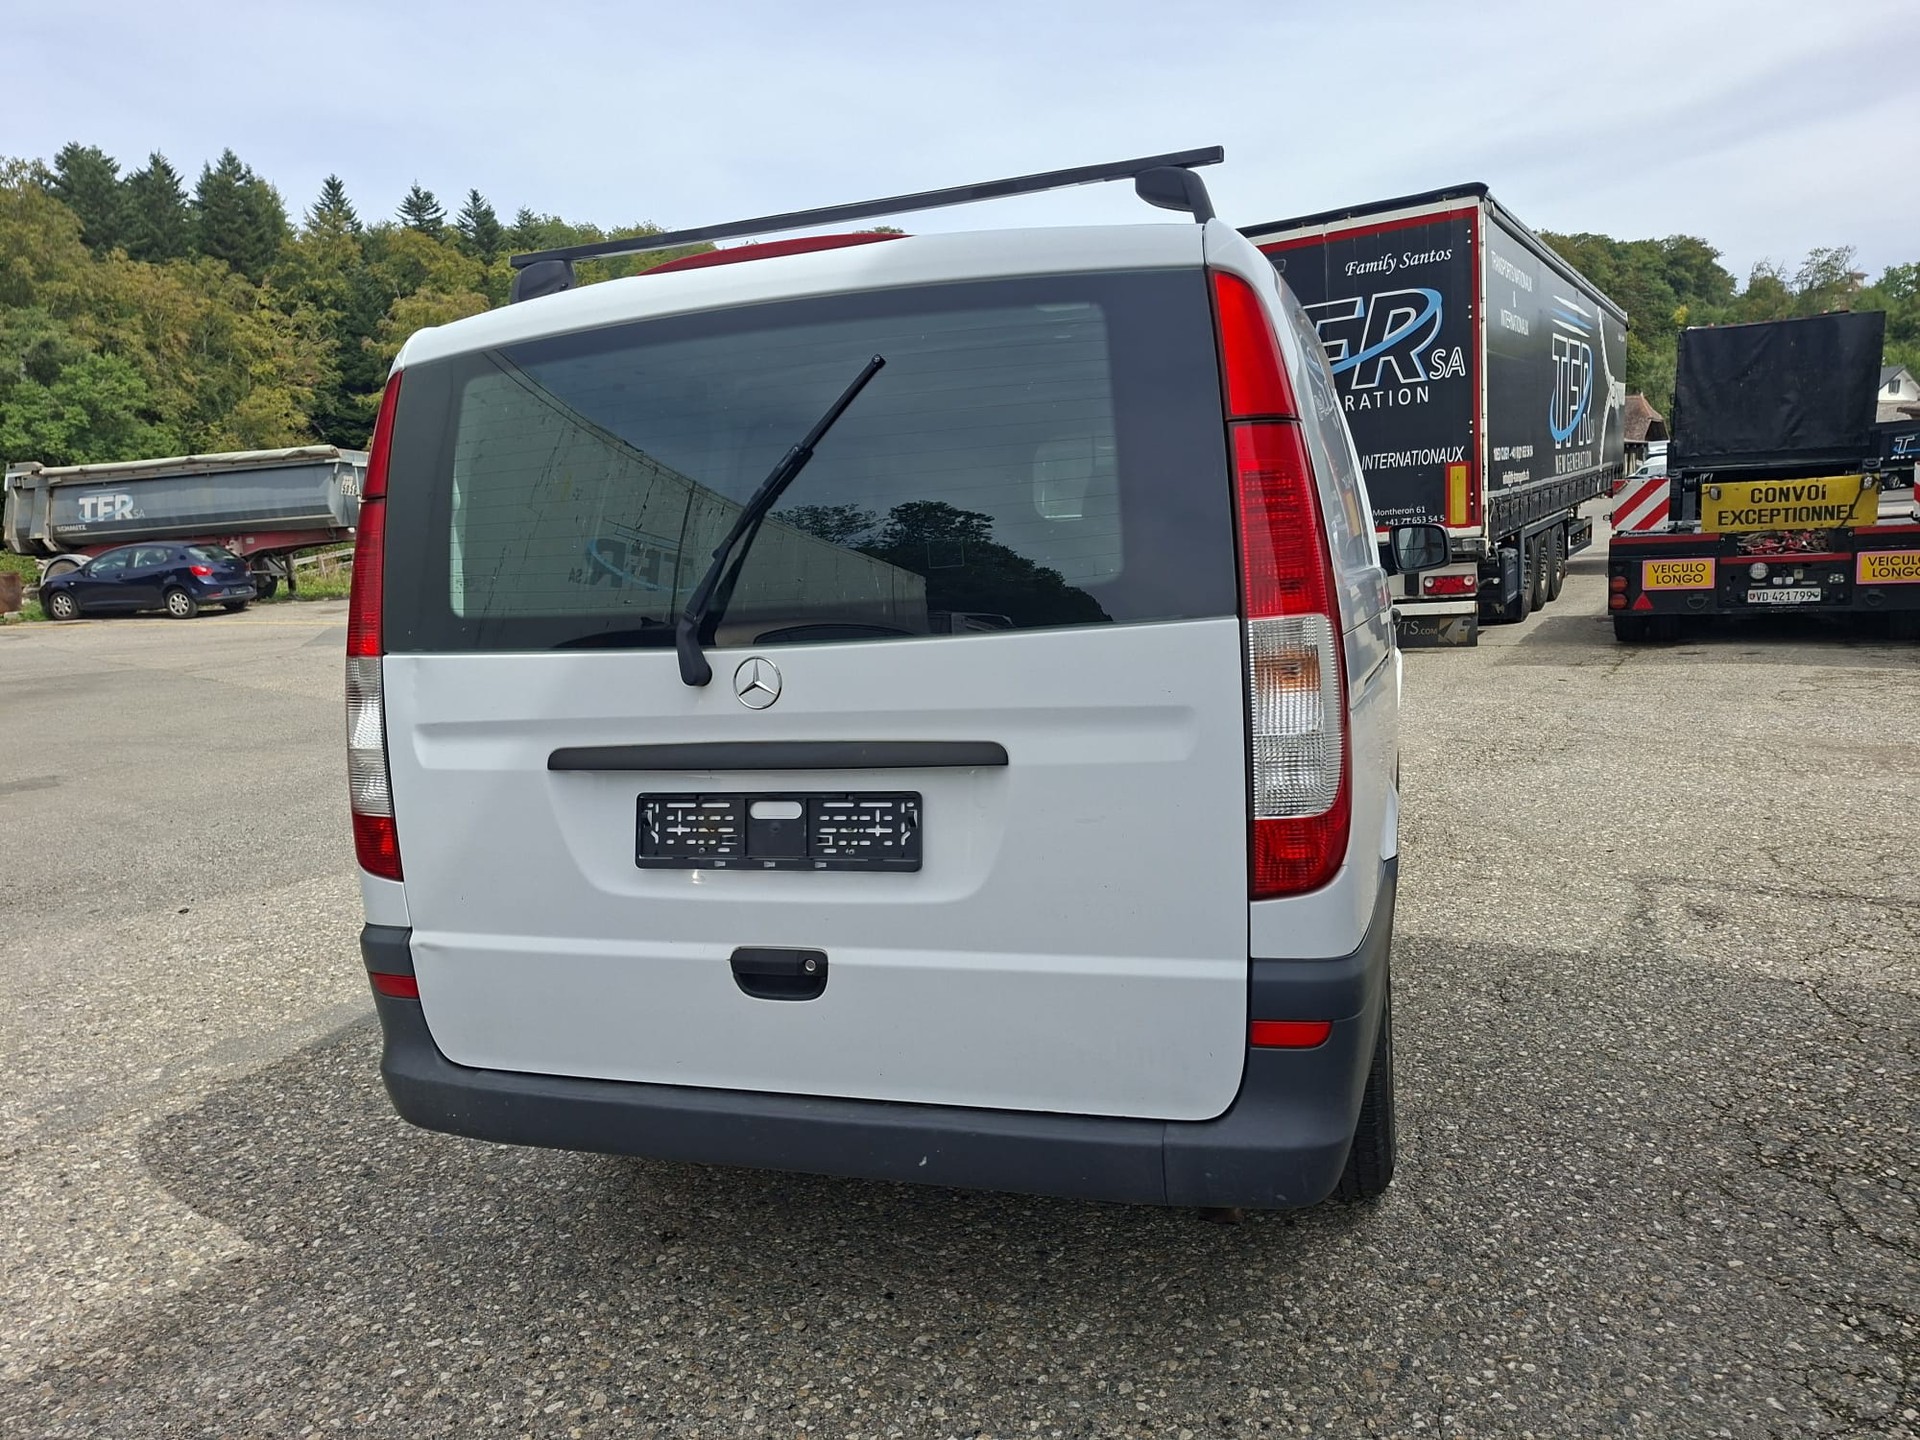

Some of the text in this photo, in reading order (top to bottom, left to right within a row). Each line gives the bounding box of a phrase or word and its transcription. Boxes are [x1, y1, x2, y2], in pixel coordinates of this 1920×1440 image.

[1345, 248, 1453, 276] Family Santos
[1429, 346, 1466, 380] SA
[1344, 386, 1428, 411] RATION
[1361, 445, 1465, 471] INTERNATIONAUX
[1372, 506, 1426, 517] Montheron 61
[1717, 504, 1859, 526] EXCEPTIONNEL
[1385, 518, 1398, 526] +41
[1428, 515, 1438, 523] 54
[1868, 555, 1920, 567] VEICUL
[1652, 563, 1706, 574] VEICULO
[1656, 573, 1704, 584] LONGO
[1757, 592, 1769, 601] VD
